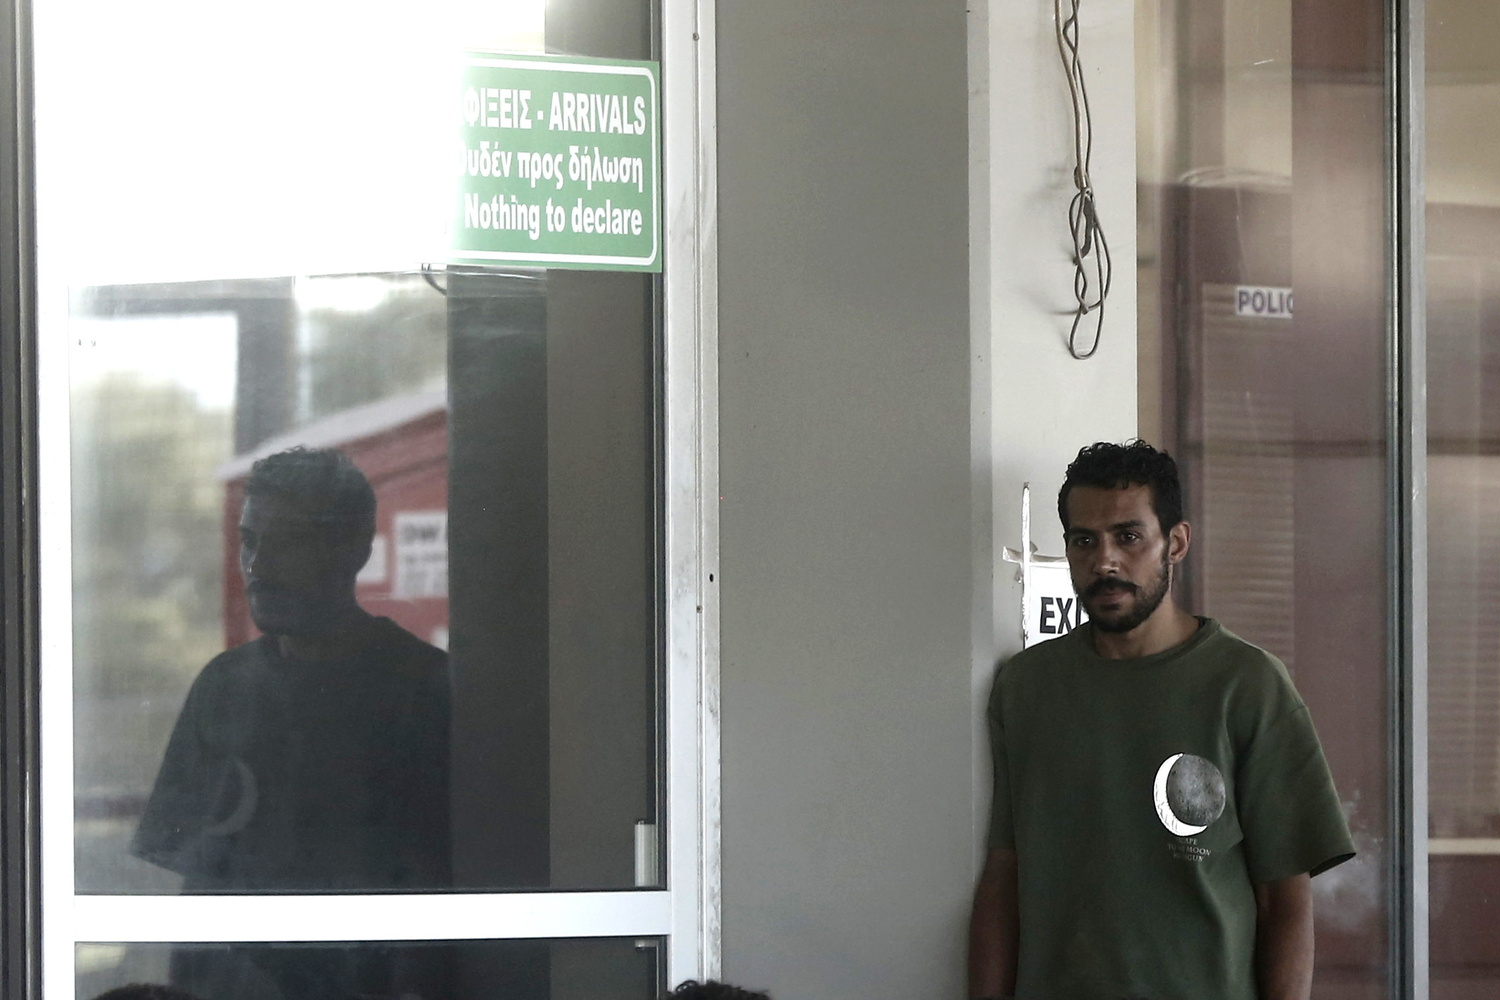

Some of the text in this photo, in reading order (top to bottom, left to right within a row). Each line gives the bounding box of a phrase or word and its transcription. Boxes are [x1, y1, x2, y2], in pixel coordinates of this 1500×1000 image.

[461, 86, 532, 129] ΦΙΞΕΙΣ
[549, 92, 646, 135] ARRIVALS
[517, 151, 563, 190] προς
[569, 145, 643, 192] δήλωση
[464, 193, 642, 240] Nothing to declare
